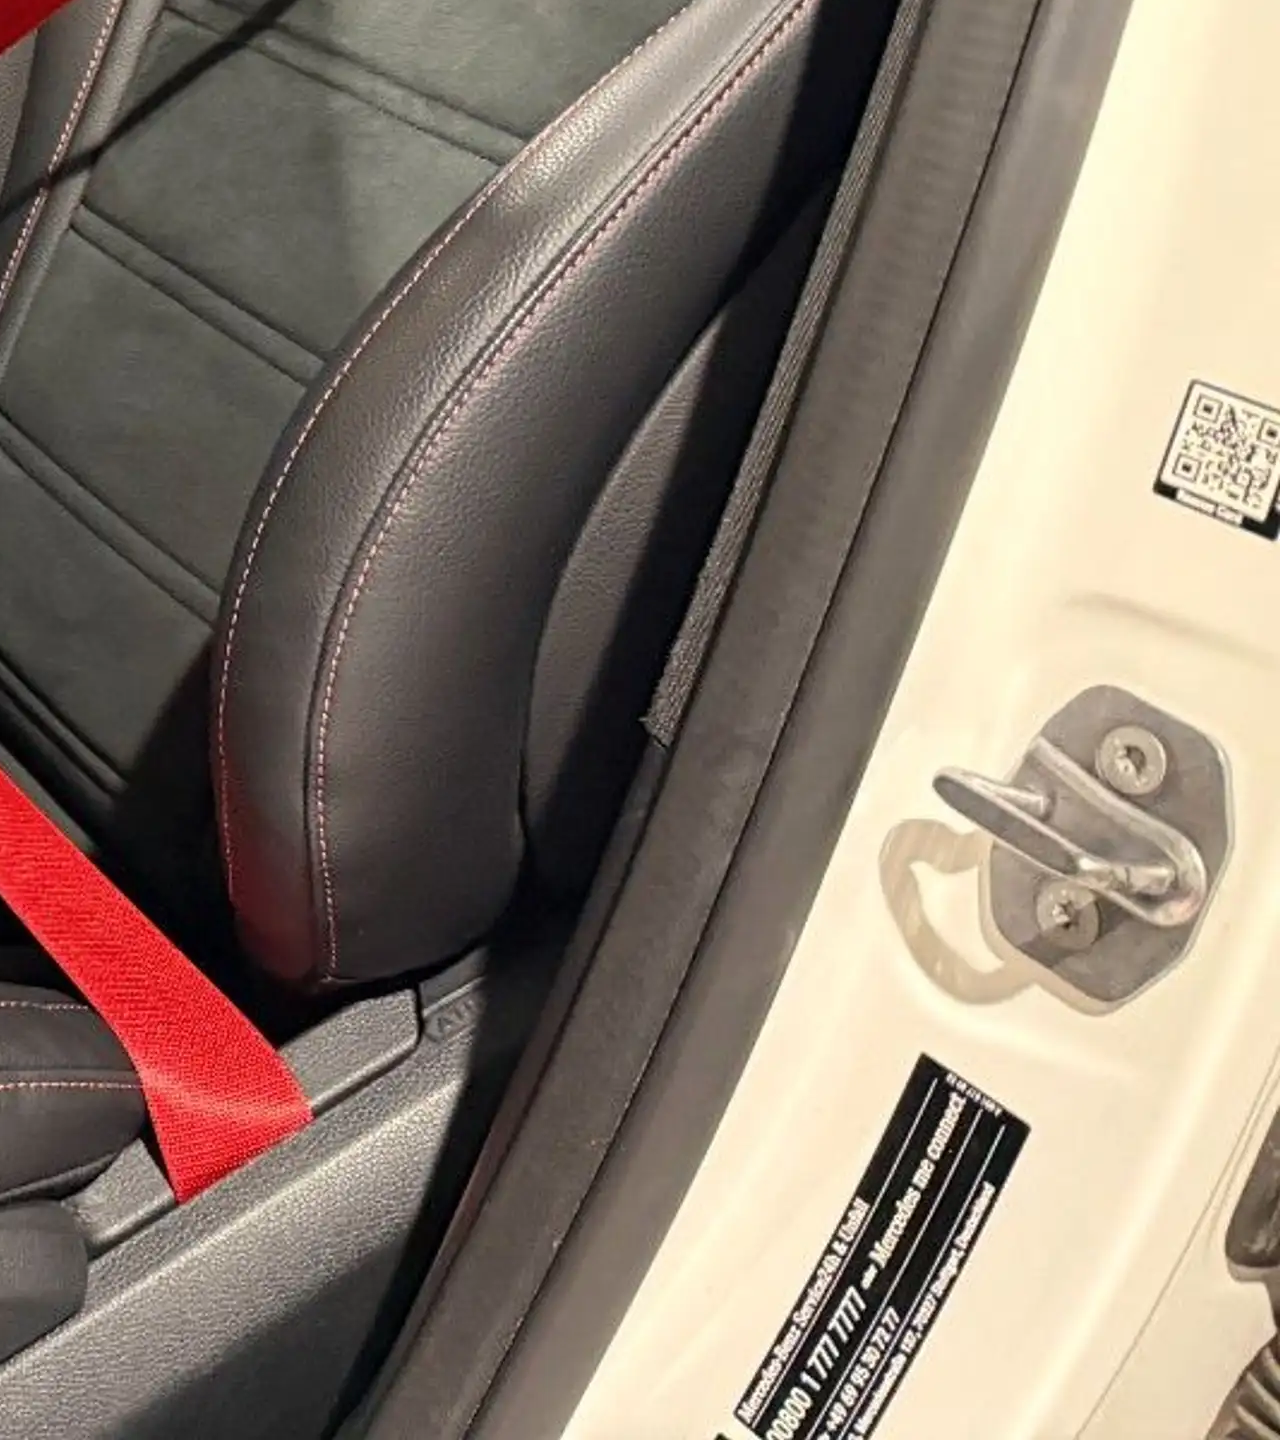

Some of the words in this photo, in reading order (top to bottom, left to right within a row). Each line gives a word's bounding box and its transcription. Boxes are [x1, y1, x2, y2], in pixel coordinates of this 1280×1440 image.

[805, 1331, 840, 1380] 777
[826, 1284, 867, 1344] 7777
[867, 1185, 922, 1269] Mercedes
[910, 1156, 936, 1191] me
[925, 1090, 967, 1161] connect
